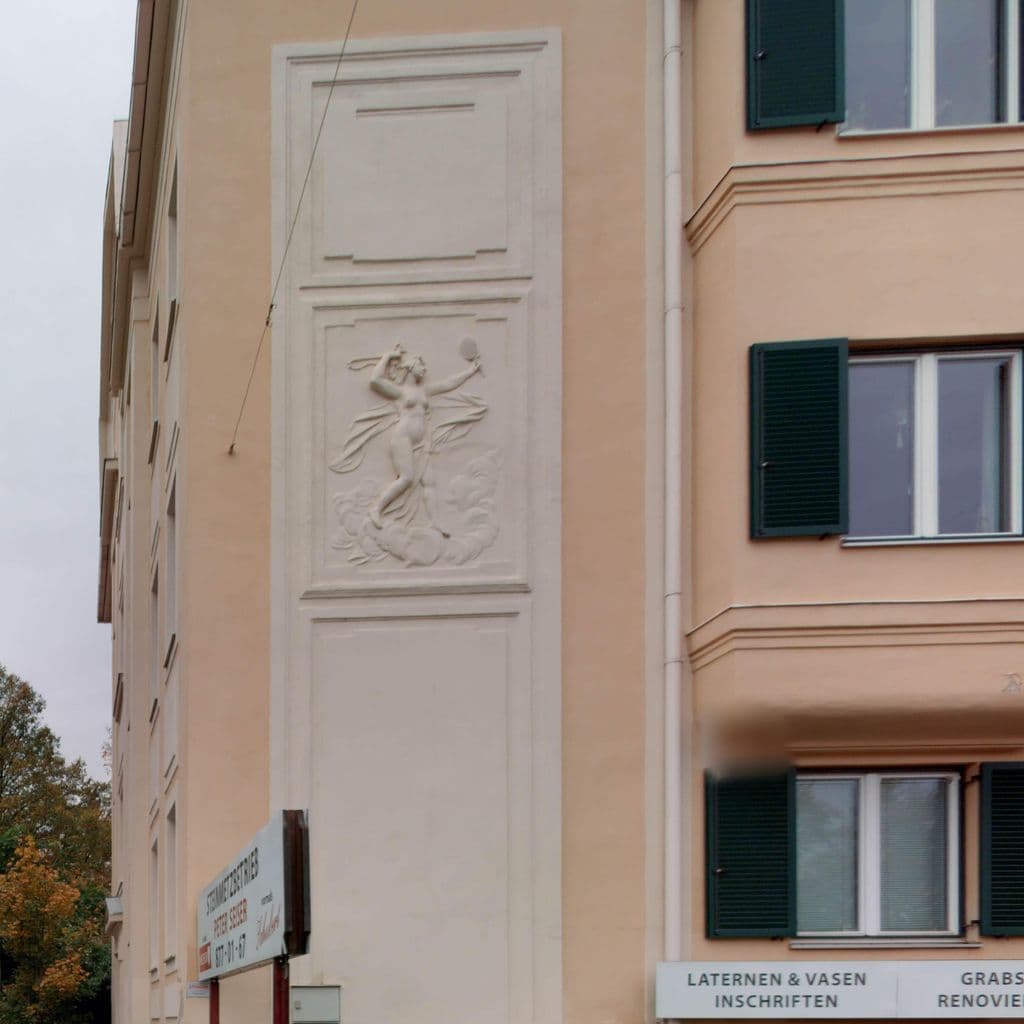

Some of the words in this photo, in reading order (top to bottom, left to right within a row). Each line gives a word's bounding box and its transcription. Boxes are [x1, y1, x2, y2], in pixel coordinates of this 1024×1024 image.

[206, 847, 259, 916] STEINMETZBETRIEB
[214, 911, 228, 939] PETER
[687, 972, 782, 986] LATERNEN
[787, 972, 800, 986] &
[805, 972, 866, 986] VASEN
[961, 971, 1024, 986] GRABS
[715, 994, 838, 1008] INSCHRIFTEN
[938, 994, 1024, 1008] RENOVIE
